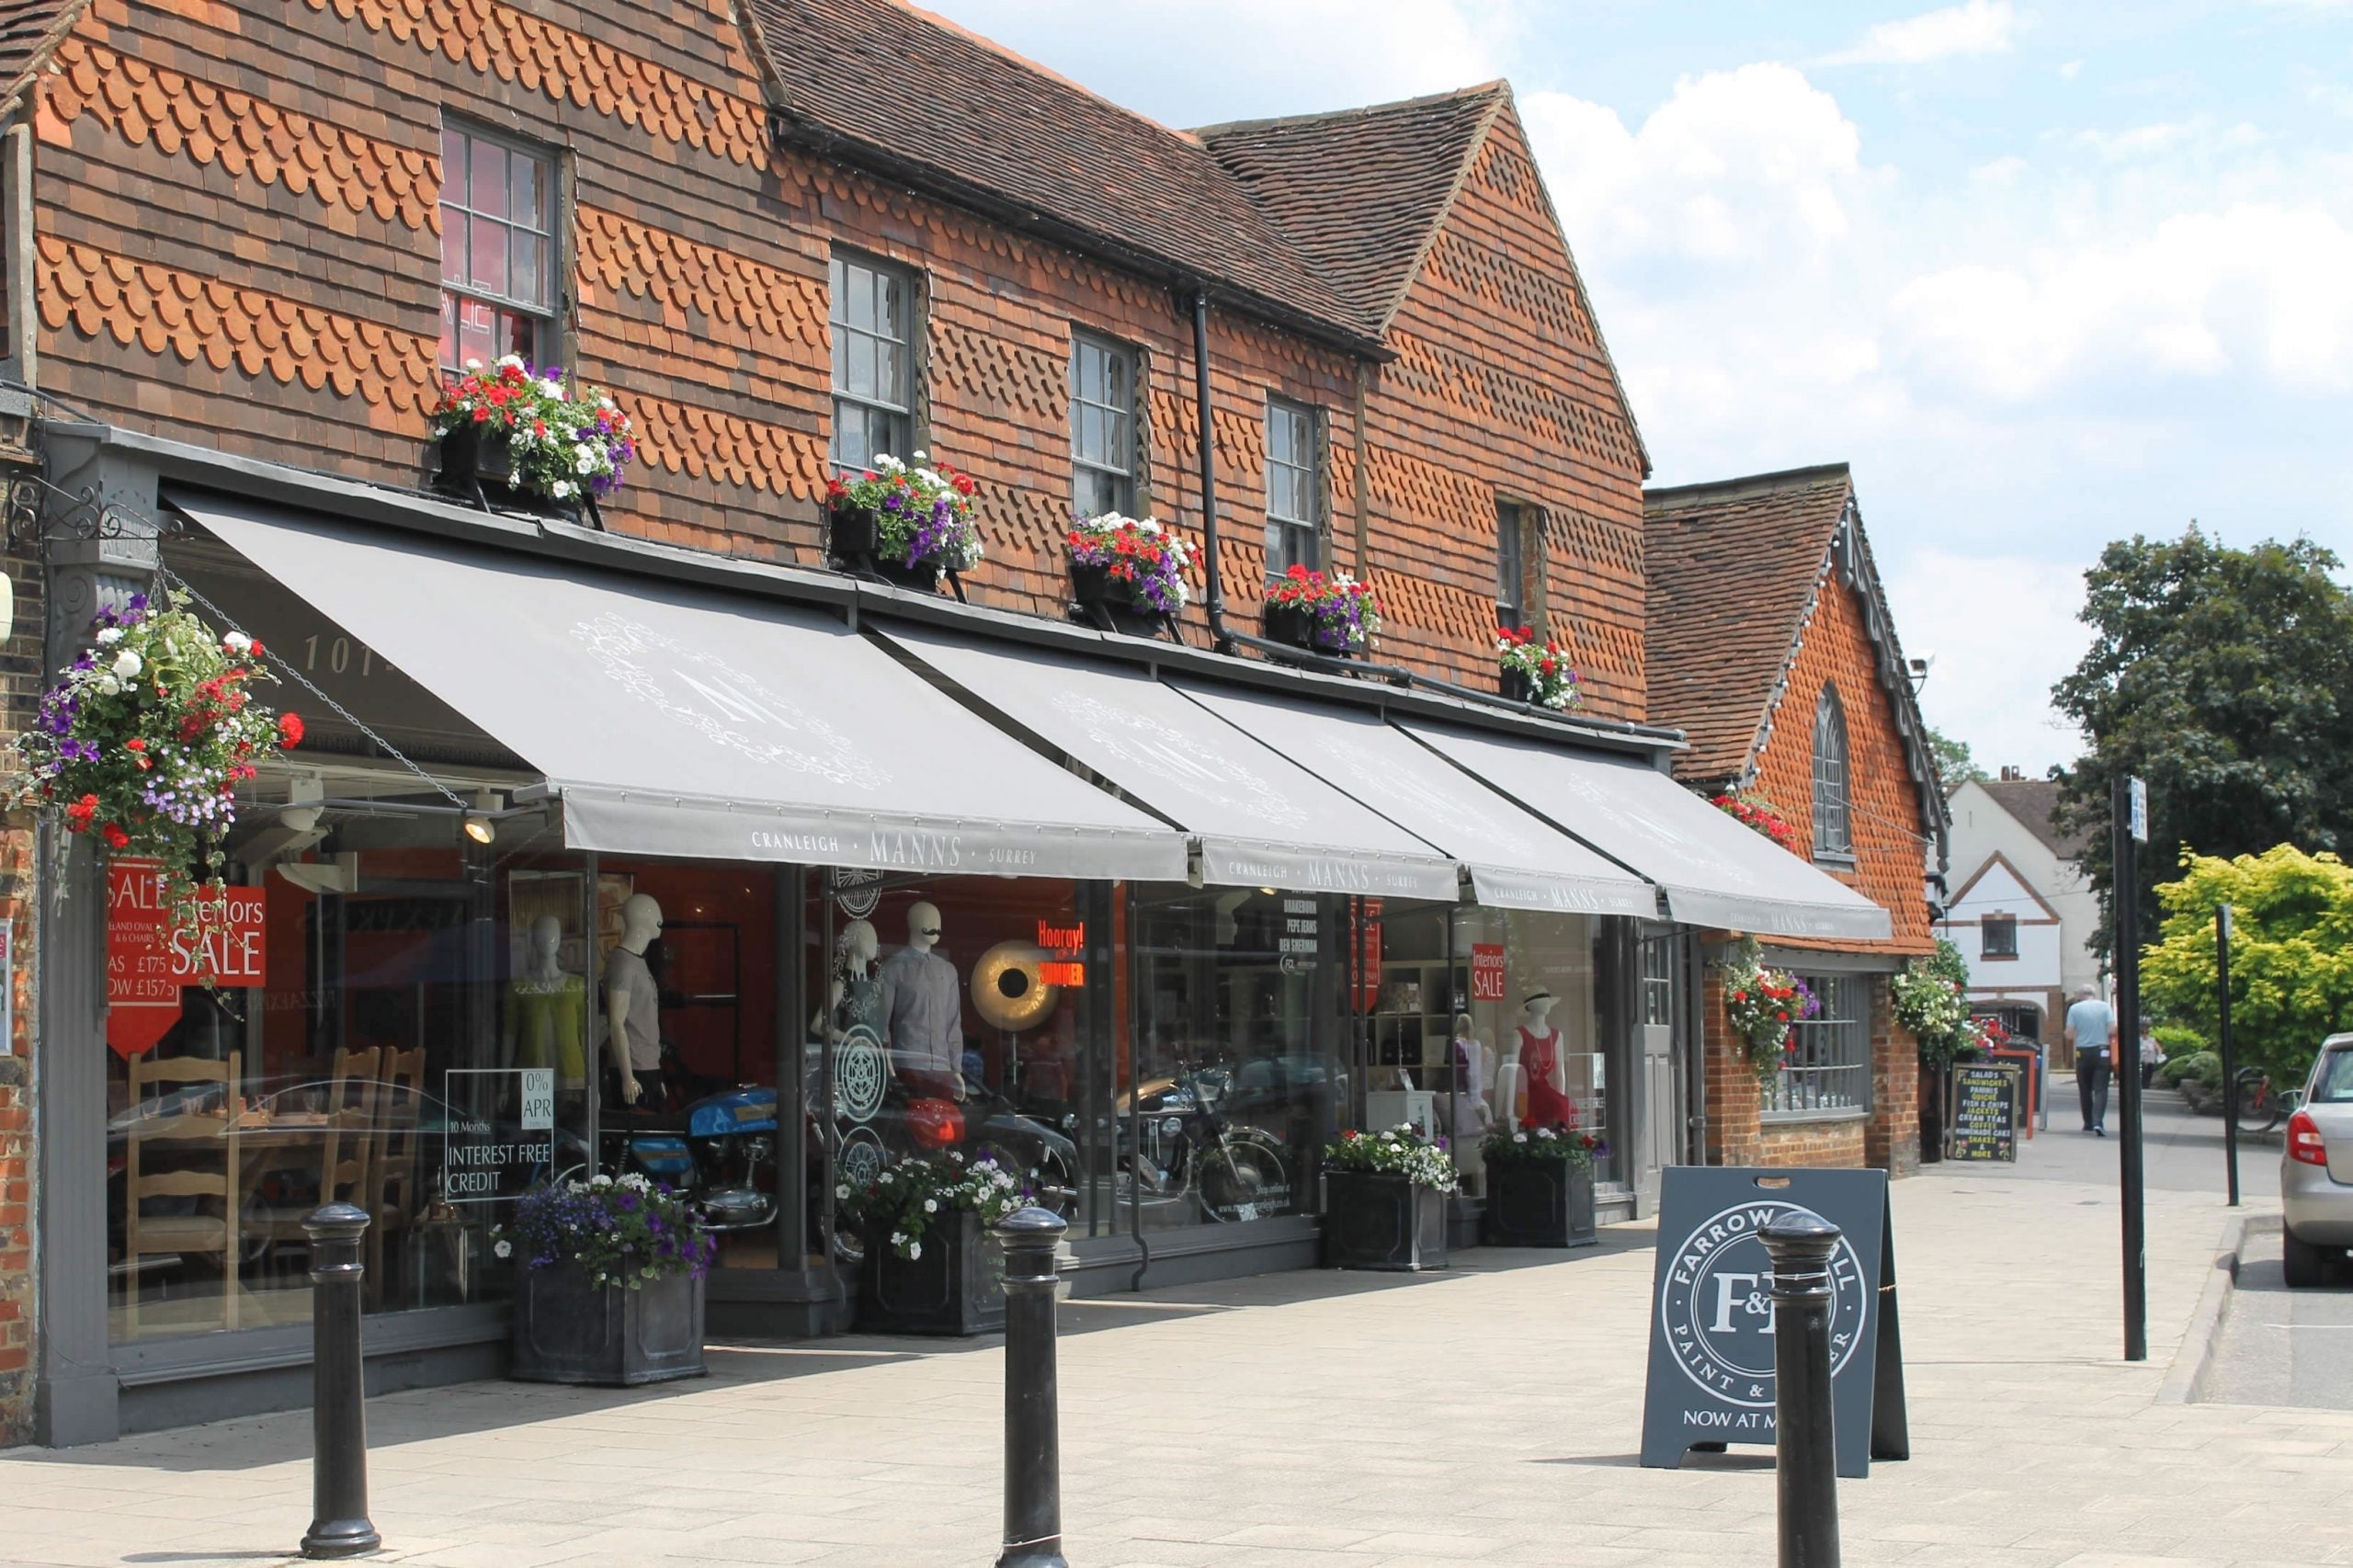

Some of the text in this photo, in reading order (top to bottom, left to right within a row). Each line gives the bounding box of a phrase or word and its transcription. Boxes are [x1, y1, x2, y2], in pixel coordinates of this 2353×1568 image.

[751, 830, 1037, 866] CRANLEIGH MANNS SURREY
[1229, 861, 1288, 879] CRANLEIGH
[1308, 859, 1370, 890] MANNS
[1551, 886, 1598, 910] MANNS
[176, 892, 264, 924] nteriors
[133, 921, 153, 932] OVAL
[1287, 919, 1317, 934] PEPE JEANS
[122, 933, 128, 942] 6
[128, 933, 154, 942] CHAIRS
[1038, 919, 1084, 956] Hooray!
[1279, 938, 1317, 953] BEN SHERMAN
[171, 928, 261, 975] SALE
[1473, 949, 1504, 968] Interiors
[108, 955, 167, 973] AS £175
[108, 978, 132, 996] OW
[1474, 971, 1504, 997] SALE
[526, 1073, 549, 1092] 0%
[1962, 1078, 2007, 1086] SANDWICHES
[1971, 1071, 1999, 1079] SALADS
[523, 1098, 551, 1119] APR
[1962, 1099, 1979, 1108] FISH
[1987, 1101, 2009, 1109] CHIPS
[460, 1119, 491, 1133] Months
[1959, 1114, 2006, 1123] CREAM TEAS
[1993, 1129, 2011, 1137] CAKE
[449, 1143, 551, 1166] INTEREST FREE
[1972, 1150, 1993, 1158] MORE
[448, 1171, 501, 1194] CREDIT
[1675, 1208, 1775, 1285] FARROW
[1827, 1243, 1855, 1291] ALL
[1674, 1324, 1764, 1398] PAINT &
[1684, 1409, 1733, 1426] NOW
[1735, 1412, 1760, 1428] AT
